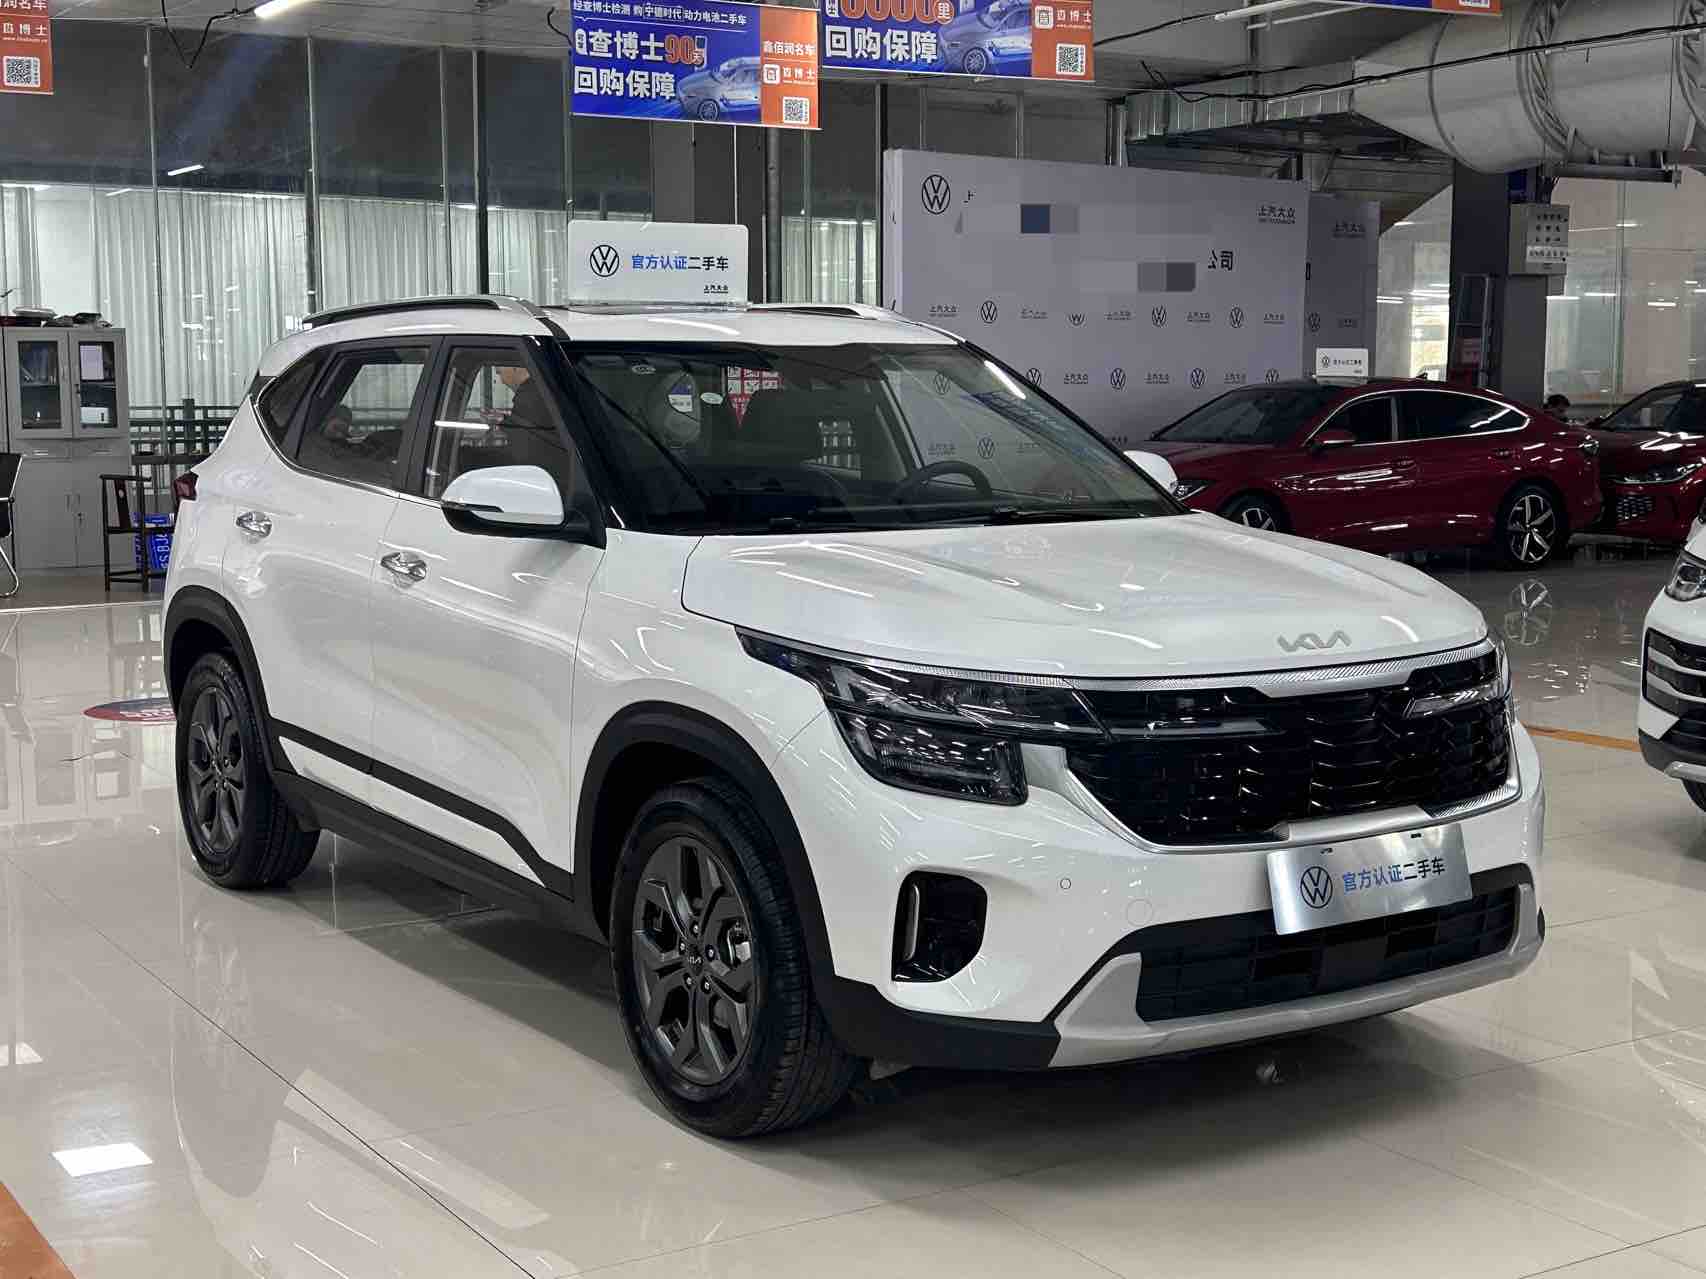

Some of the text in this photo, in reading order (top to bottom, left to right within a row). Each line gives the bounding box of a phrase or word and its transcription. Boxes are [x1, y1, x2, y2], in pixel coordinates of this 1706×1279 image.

[826, 25, 937, 63] 回购保障
[574, 66, 676, 99] 回购保障
[631, 255, 729, 271] 官方认证二手车
[1342, 856, 1446, 894] 官方认证二手车
